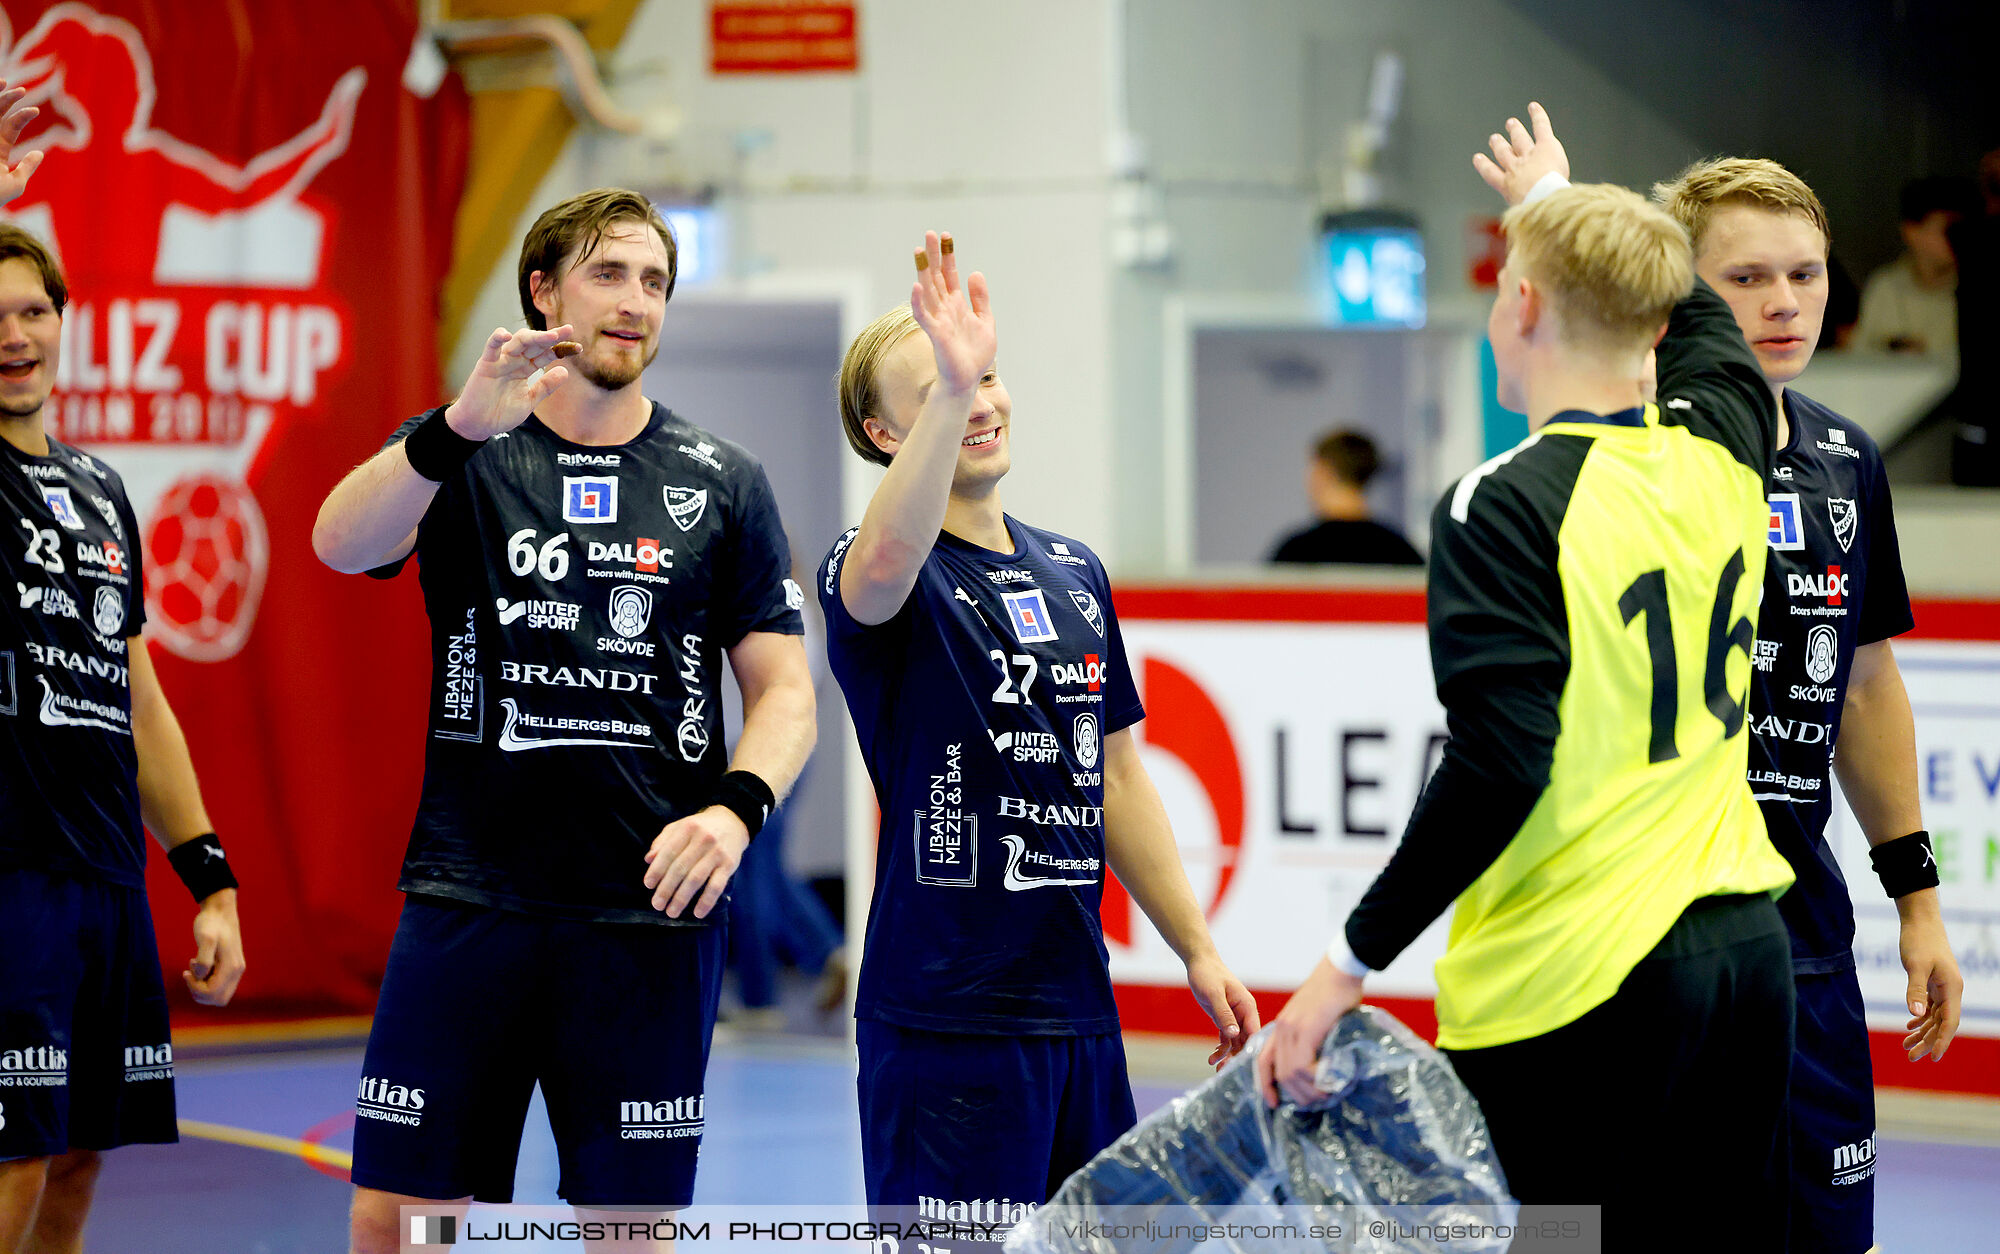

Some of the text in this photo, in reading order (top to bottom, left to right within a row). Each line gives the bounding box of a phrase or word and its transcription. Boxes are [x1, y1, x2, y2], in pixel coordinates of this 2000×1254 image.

[204, 302, 343, 406] CUP
[556, 453, 622, 466] RIMAC
[20, 517, 65, 574] 23
[507, 528, 570, 582] 66
[587, 541, 674, 570] DALOC
[587, 568, 613, 579] Doors
[614, 570, 634, 580] with
[1787, 573, 1849, 597] DALOC
[527, 600, 580, 618] INTER
[527, 614, 580, 631] SPORT
[1790, 605, 1811, 616] Doors
[596, 637, 656, 658] SKÖVDE
[1617, 545, 1756, 765] 16
[443, 635, 464, 720] LIBANON
[460, 607, 477, 721] MEZE & BAR
[499, 660, 659, 695] BRANDT
[989, 649, 1039, 706] 27
[1050, 661, 1107, 685] DALOC
[679, 634, 709, 750] PRIMA
[1055, 694, 1075, 704] Doors
[1014, 731, 1059, 749] INTER
[1013, 747, 1060, 764] SPORT
[945, 742, 962, 864] MEZE & BAR
[997, 795, 1104, 827] BRANDT
[928, 775, 945, 864] LIBANON
[0, 1044, 68, 1070] attias
[621, 1129, 665, 1140] CATERING
[666, 1129, 673, 1139] &
